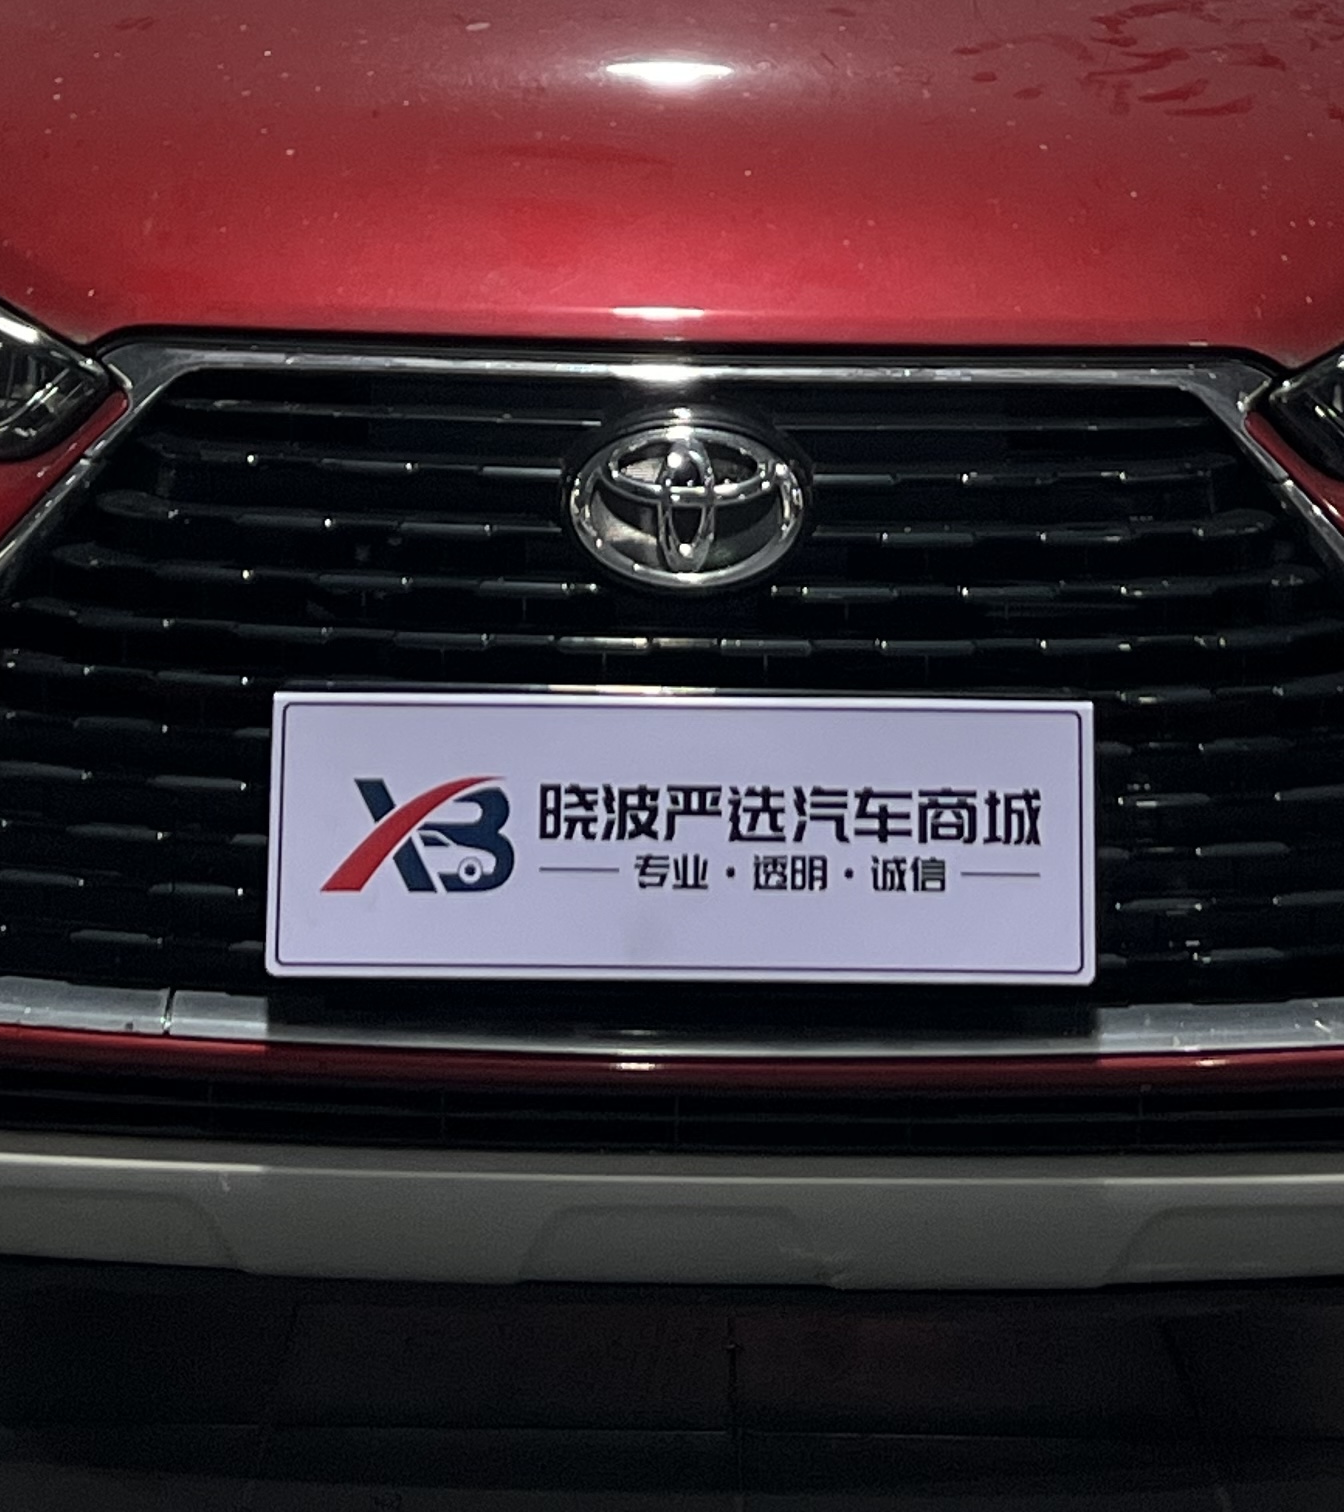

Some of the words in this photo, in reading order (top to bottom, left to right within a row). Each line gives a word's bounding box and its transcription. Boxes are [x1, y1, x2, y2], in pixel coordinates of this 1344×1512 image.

[538, 783, 1042, 846] 晓波严选汽车商城
